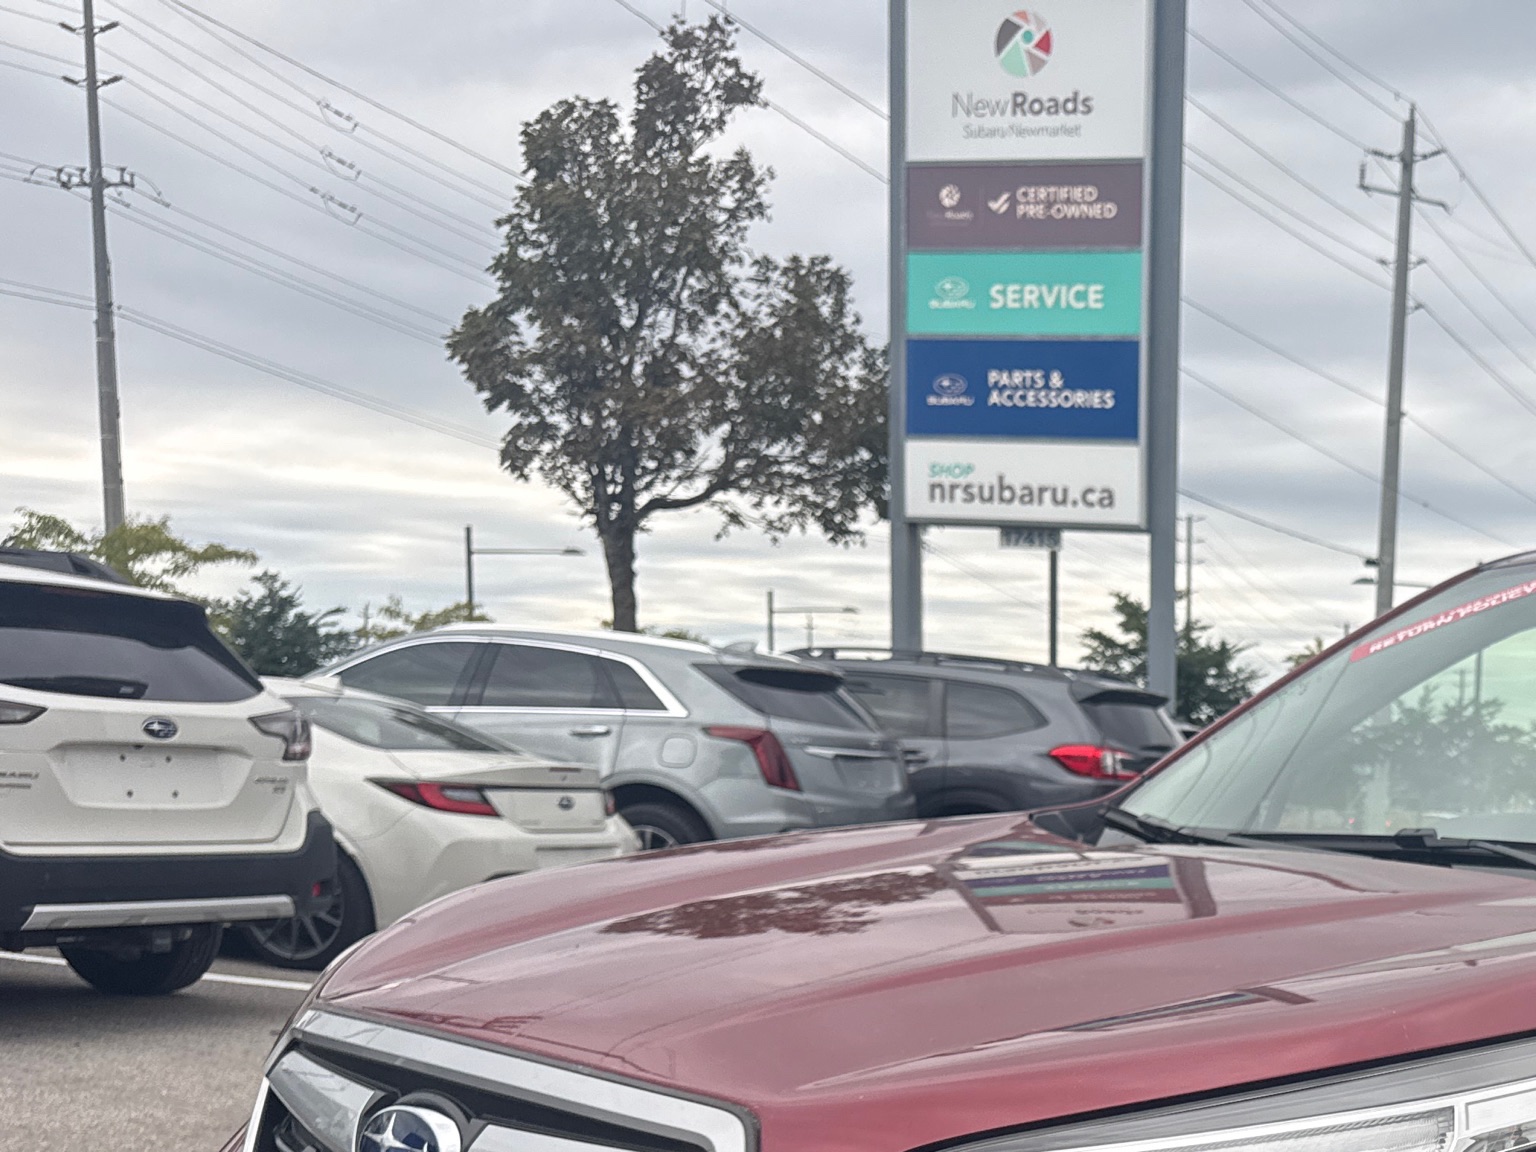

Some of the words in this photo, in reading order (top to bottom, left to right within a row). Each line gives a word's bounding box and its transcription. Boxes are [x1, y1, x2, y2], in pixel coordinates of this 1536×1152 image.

[1016, 185, 1098, 203] CERTIFIED
[1016, 202, 1118, 219] PRE-OWNED
[990, 284, 1105, 309] SERVICE
[988, 370, 1045, 388] PARTS
[1049, 370, 1064, 388] &
[988, 389, 1115, 408] ACCESSORIES
[928, 462, 975, 479] SHOP
[929, 475, 1115, 508] nrsubaru.ca
